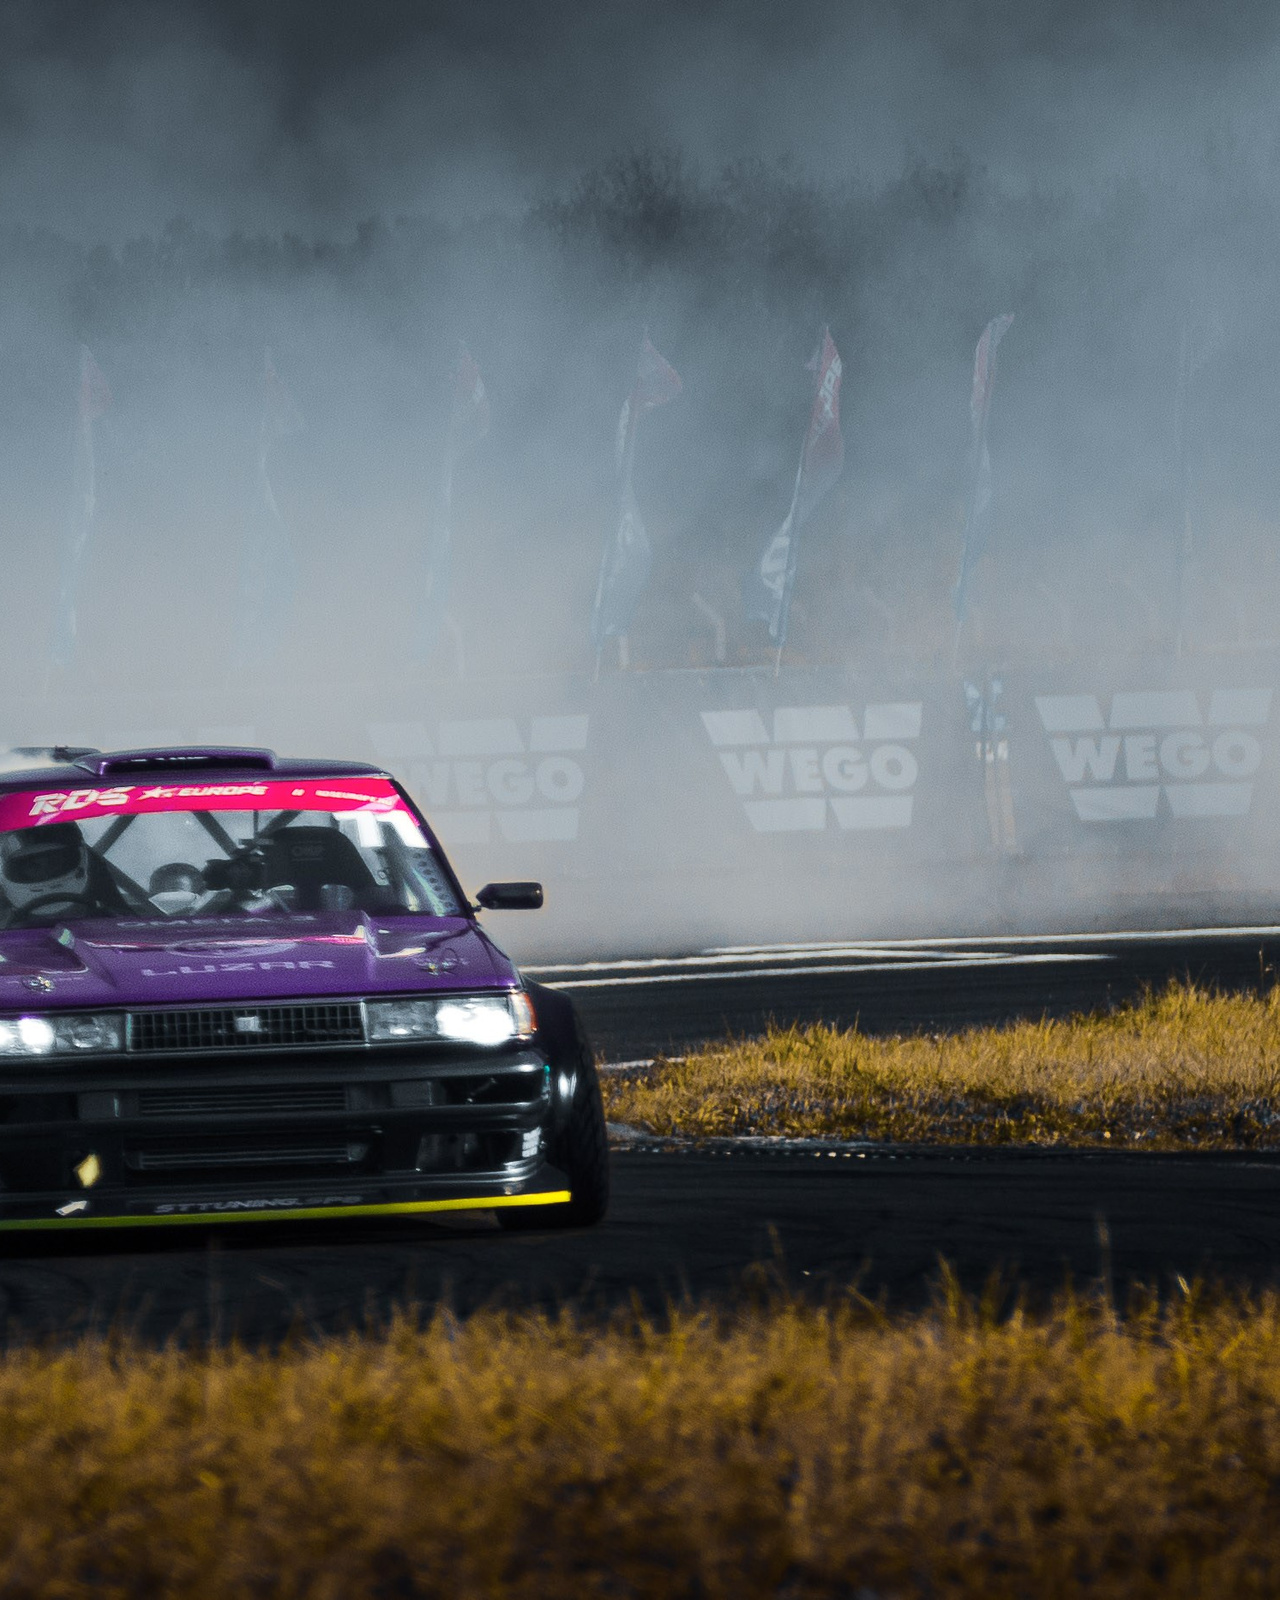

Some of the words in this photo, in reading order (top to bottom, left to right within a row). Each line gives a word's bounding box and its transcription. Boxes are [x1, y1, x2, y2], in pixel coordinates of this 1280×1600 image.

[384, 756, 585, 805] WEGO
[720, 745, 918, 794] WEGO
[1051, 731, 1263, 781] WEGO
[28, 786, 136, 816] RDS
[177, 786, 269, 797] EUROPE
[141, 960, 335, 976] LUZAR
